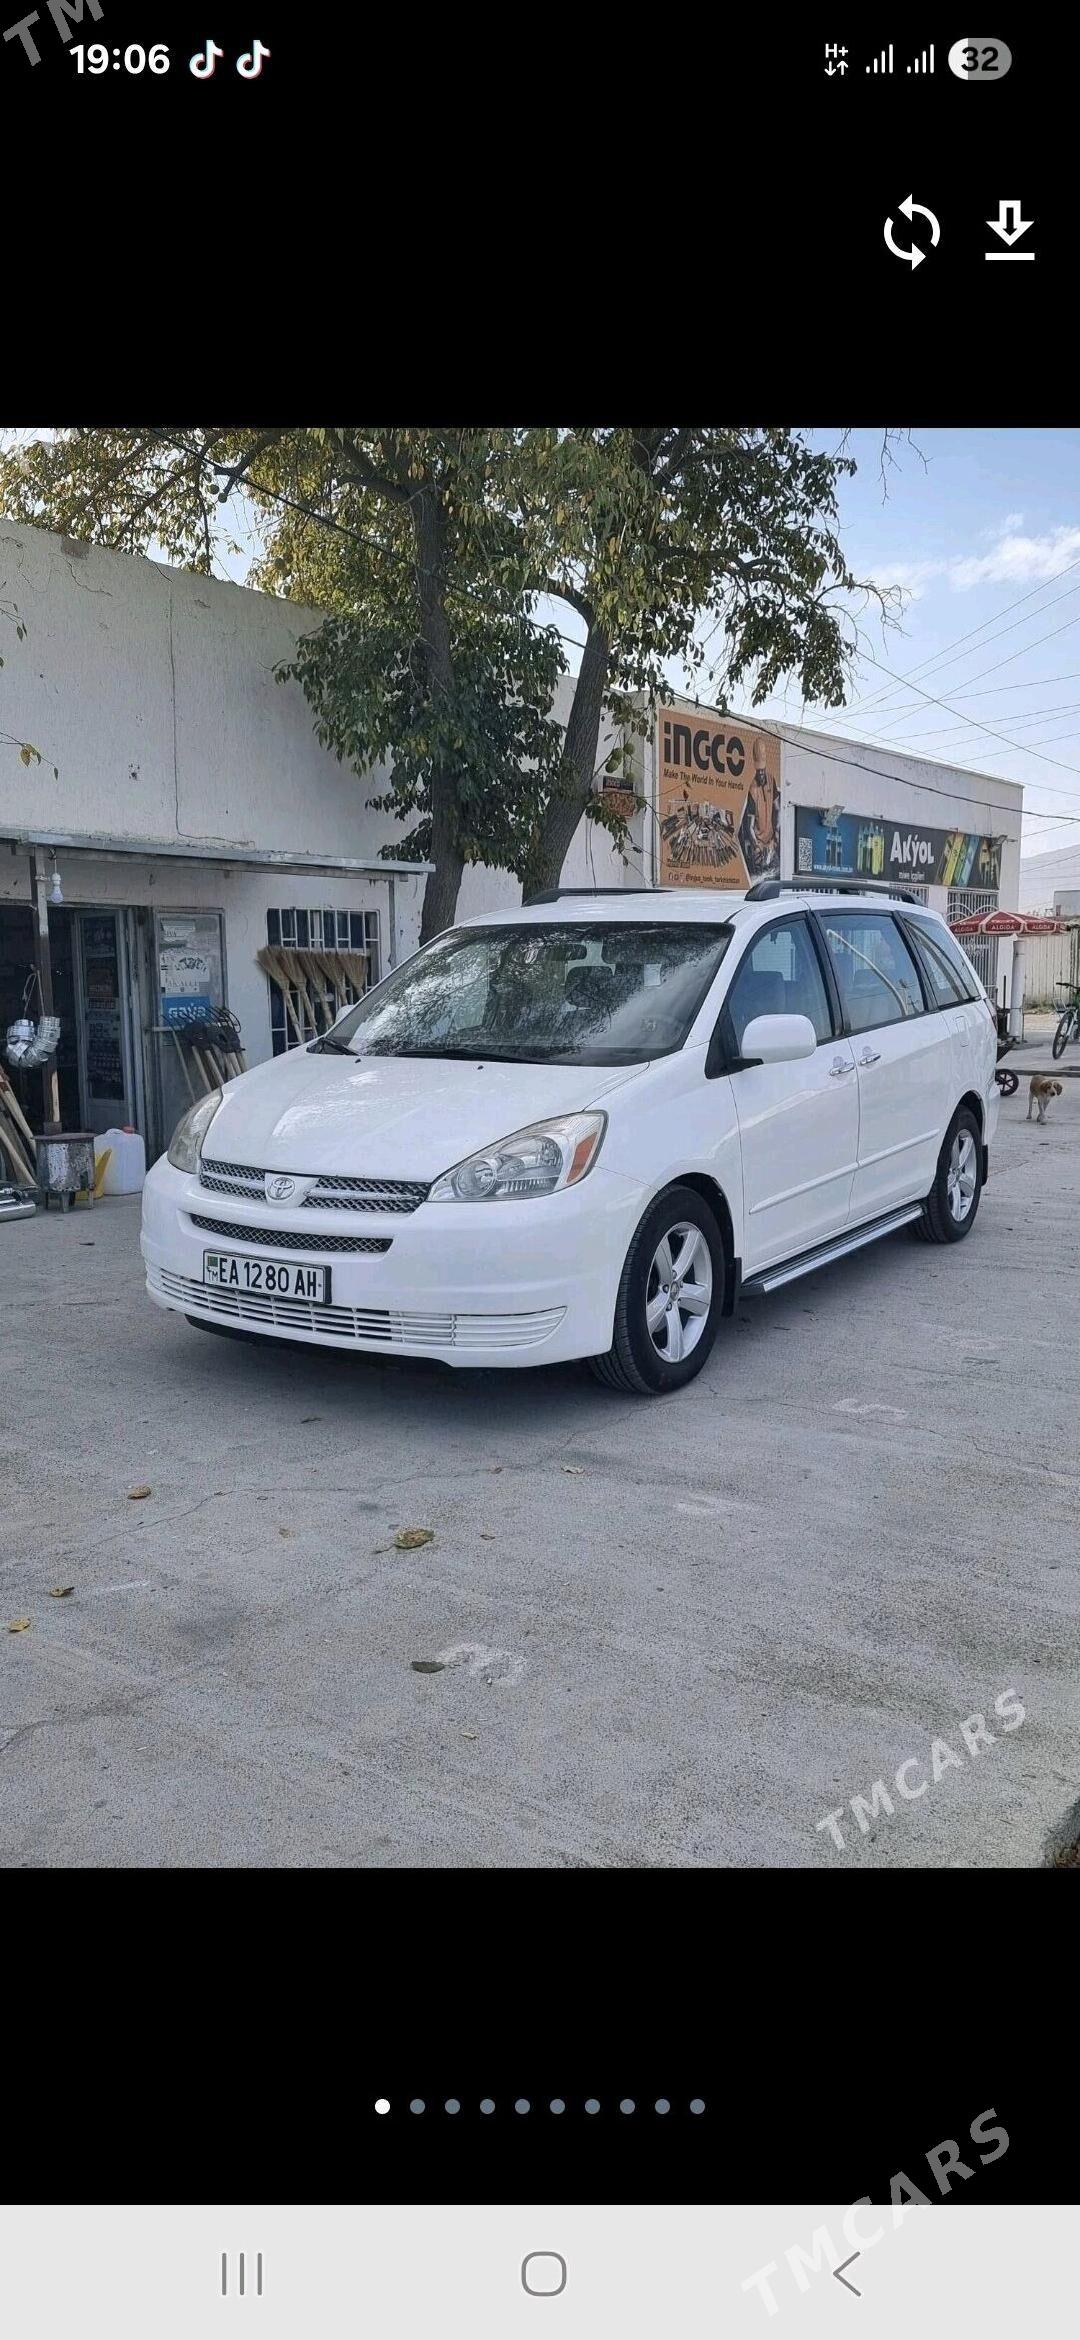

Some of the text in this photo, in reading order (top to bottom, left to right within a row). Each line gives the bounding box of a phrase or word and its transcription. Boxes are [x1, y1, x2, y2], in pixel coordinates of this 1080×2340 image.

[69, 44, 170, 74] 19:06
[961, 46, 999, 72] 32
[663, 768, 679, 780] Make
[691, 773, 708, 785] World
[715, 779, 728, 788] Your
[728, 781, 745, 791] Hands
[219, 1257, 239, 1285] EA
[244, 1261, 289, 1293] 1280
[294, 1269, 316, 1298] AH
